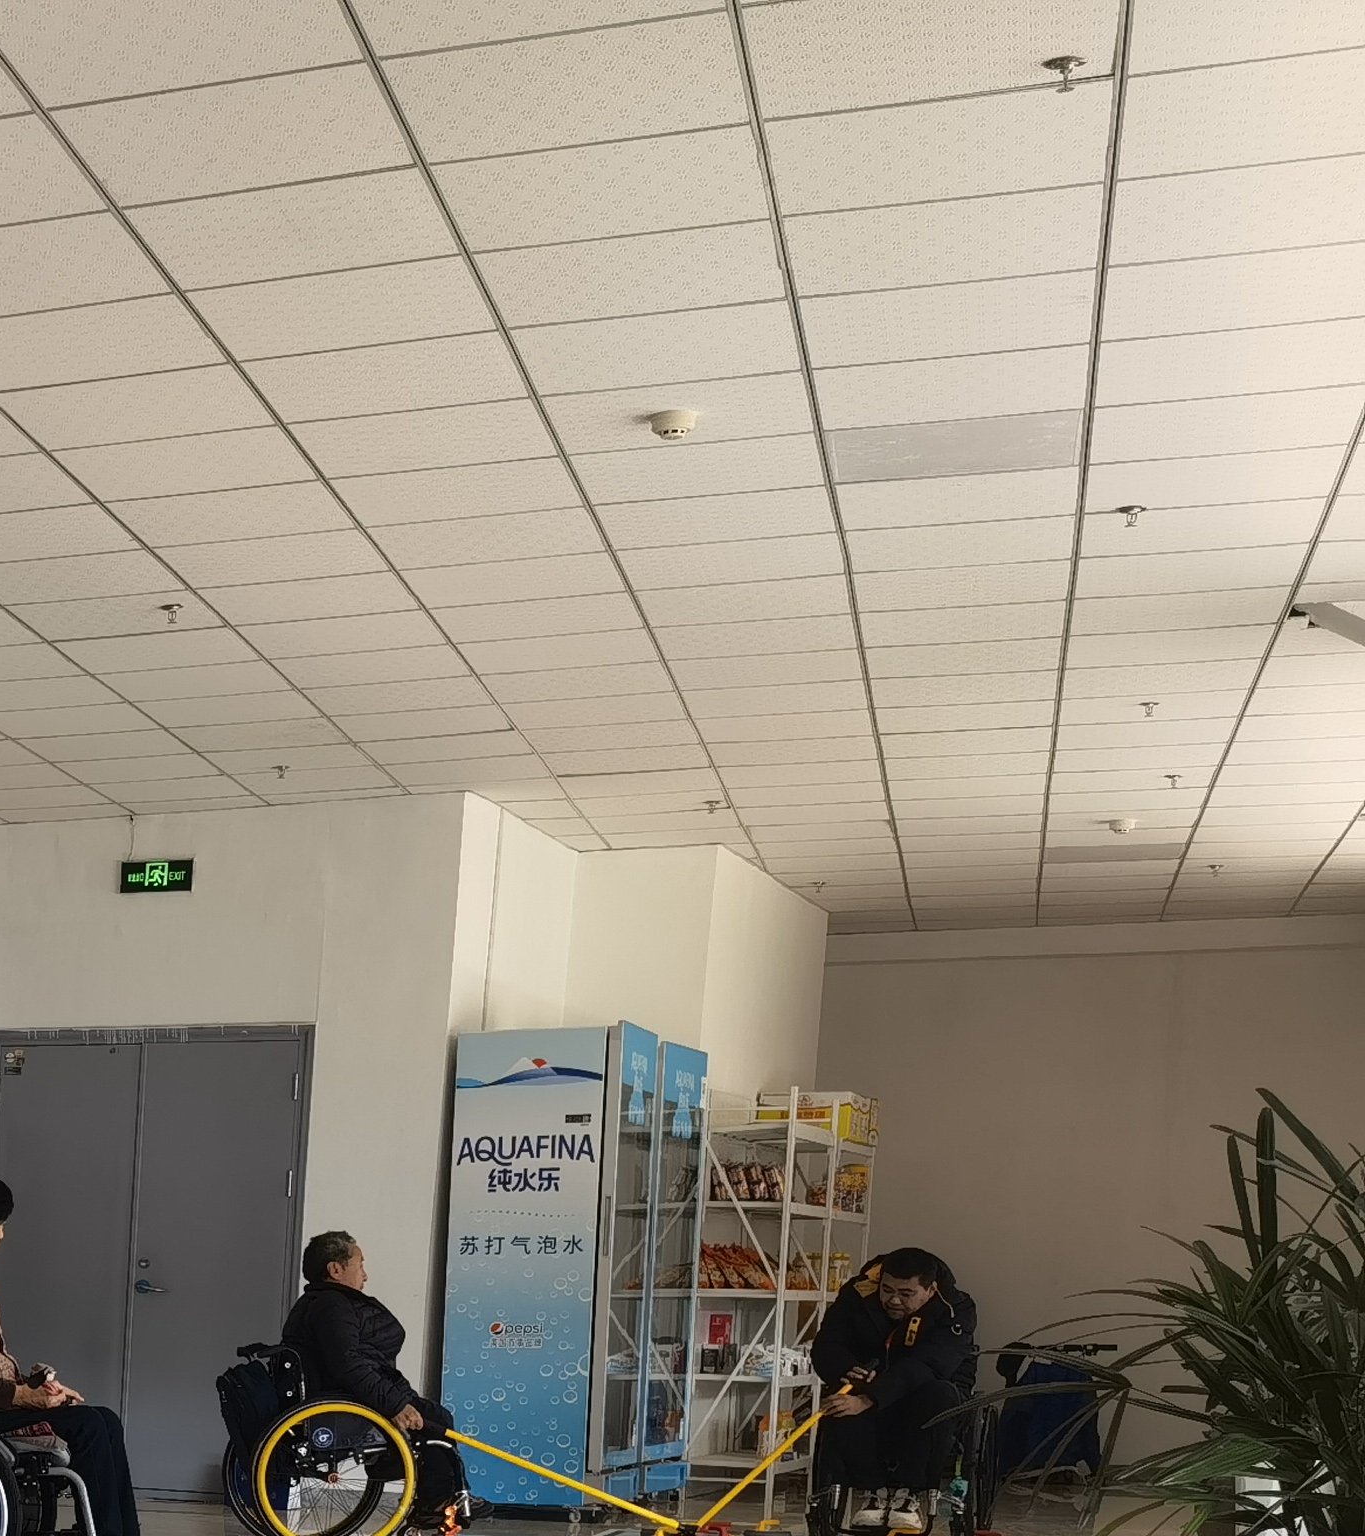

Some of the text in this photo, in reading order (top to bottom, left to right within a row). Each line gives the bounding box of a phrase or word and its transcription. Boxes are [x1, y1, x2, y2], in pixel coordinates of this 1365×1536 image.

[169, 870, 186, 881] EXIT
[456, 1134, 595, 1166] AQUAFINA
[487, 1167, 560, 1193] 纯水乐
[459, 1235, 583, 1255] 苏打气泡水
[504, 1323, 544, 1335] pepsi
